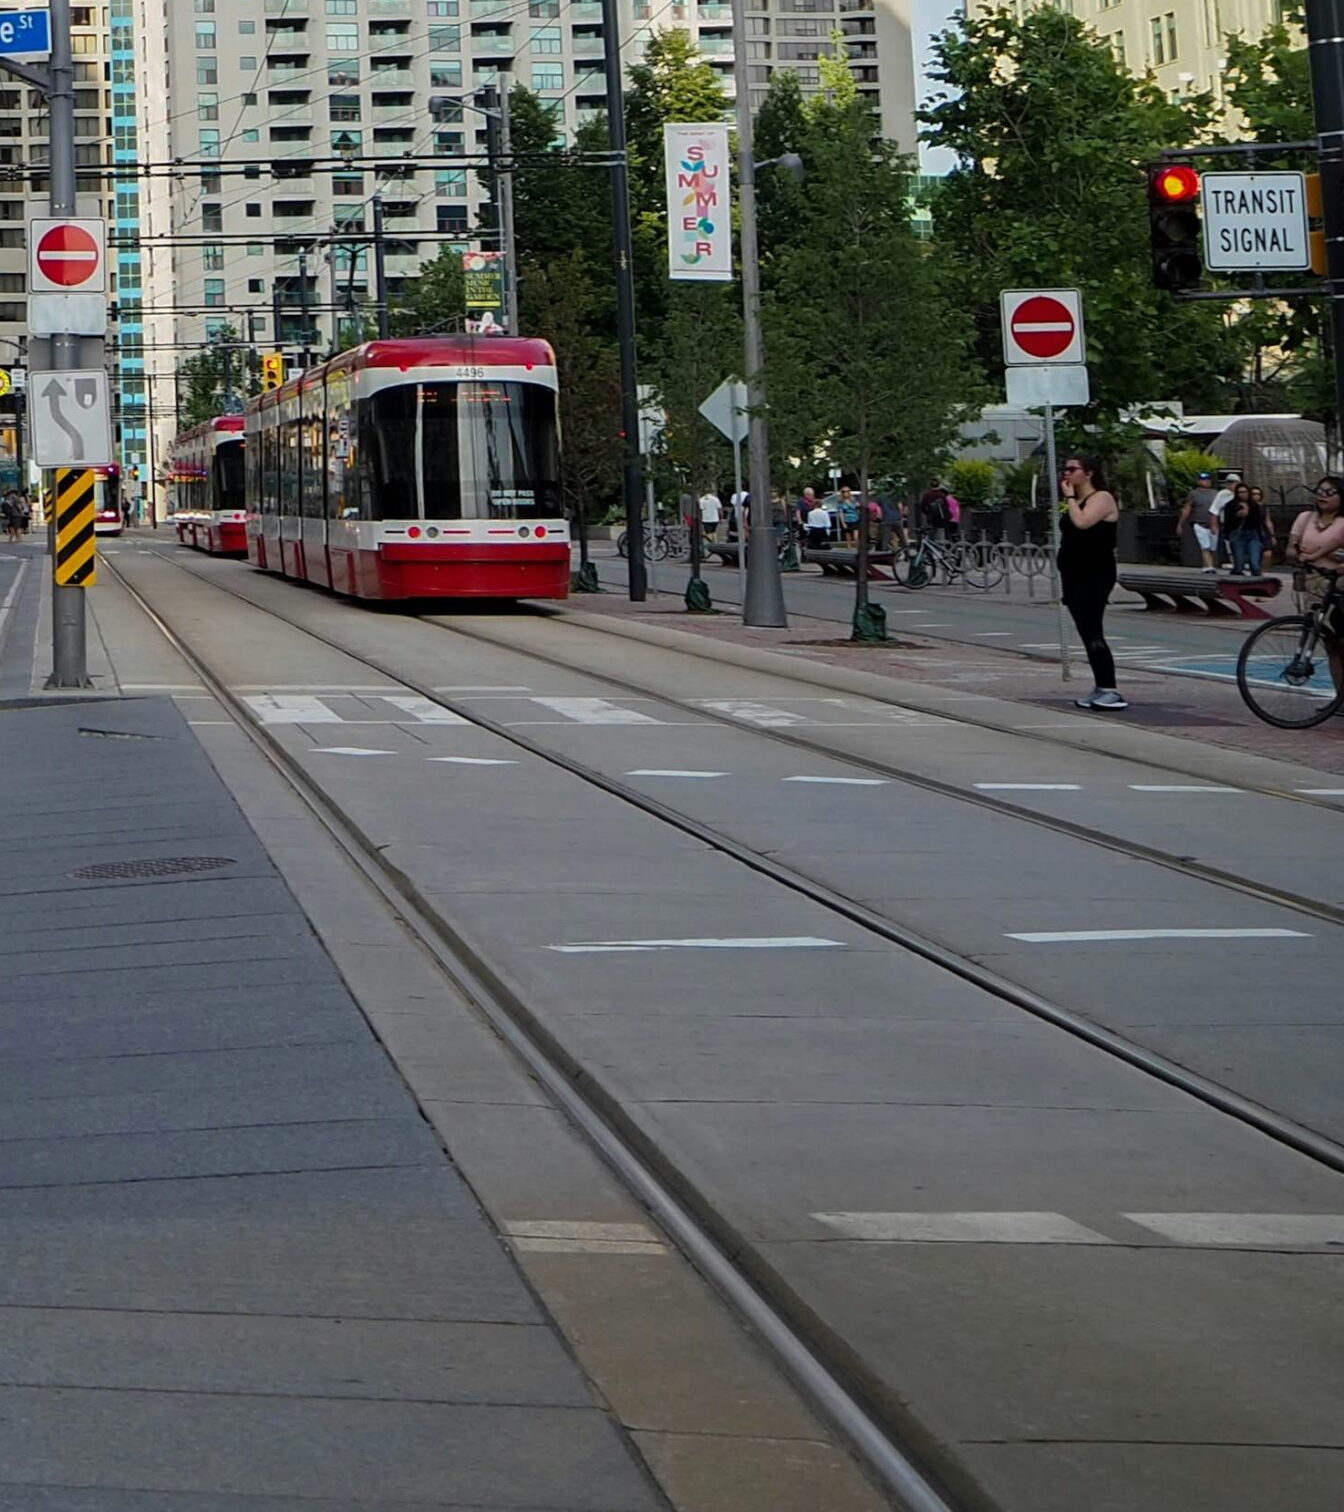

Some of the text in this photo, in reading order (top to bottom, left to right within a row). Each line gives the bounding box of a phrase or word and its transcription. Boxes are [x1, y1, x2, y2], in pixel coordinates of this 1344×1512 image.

[19, 14, 33, 29] St
[677, 146, 719, 257] SUMMER
[1211, 189, 1296, 215] TRANSIT
[1220, 228, 1295, 253] SIGNAL
[456, 367, 485, 378] 4496
